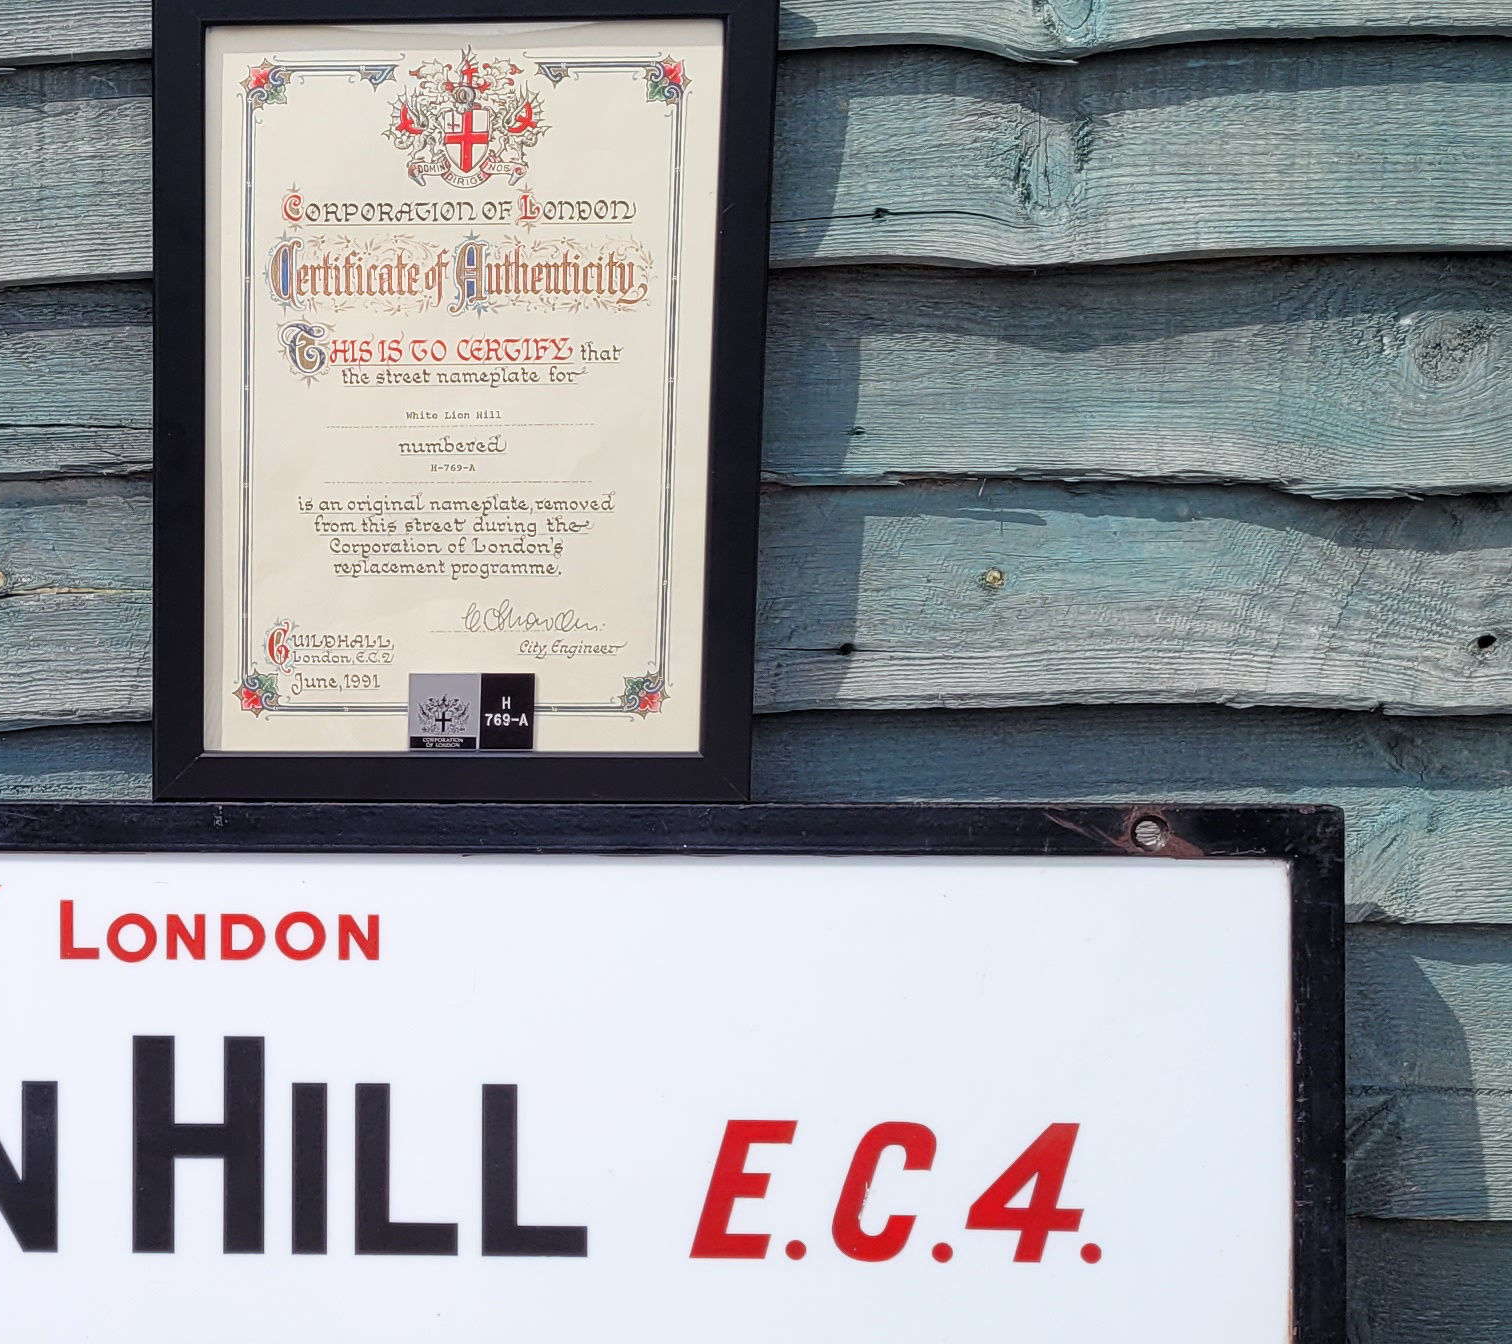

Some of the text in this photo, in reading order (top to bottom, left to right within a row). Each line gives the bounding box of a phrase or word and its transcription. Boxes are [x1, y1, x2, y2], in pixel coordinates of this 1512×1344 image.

[445, 172, 485, 186] DIRIGE
[489, 163, 510, 172] NOS
[282, 193, 637, 224] CORPORATION OF LONDON
[271, 240, 648, 315] Certificate of Authenticity
[281, 321, 624, 374] THIS IS TO CERTIFY that
[341, 365, 588, 388] the street nameplate for
[406, 410, 502, 420] White Lion Hill
[398, 435, 507, 454] numbered
[430, 464, 476, 472] H-769-A
[298, 491, 616, 516] is an original nameplate, removed
[314, 514, 594, 537] from this street during the
[329, 535, 564, 558] Corporation of London's
[333, 558, 562, 581] replacement programme.
[551, 638, 627, 659] Engineer
[291, 673, 381, 695] June, 1991
[502, 696, 511, 710] H
[485, 713, 529, 727] 769-A
[59, 899, 380, 964] LONDON
[131, 1034, 589, 1258] HILL
[688, 1118, 1103, 1266] E.C.4.
